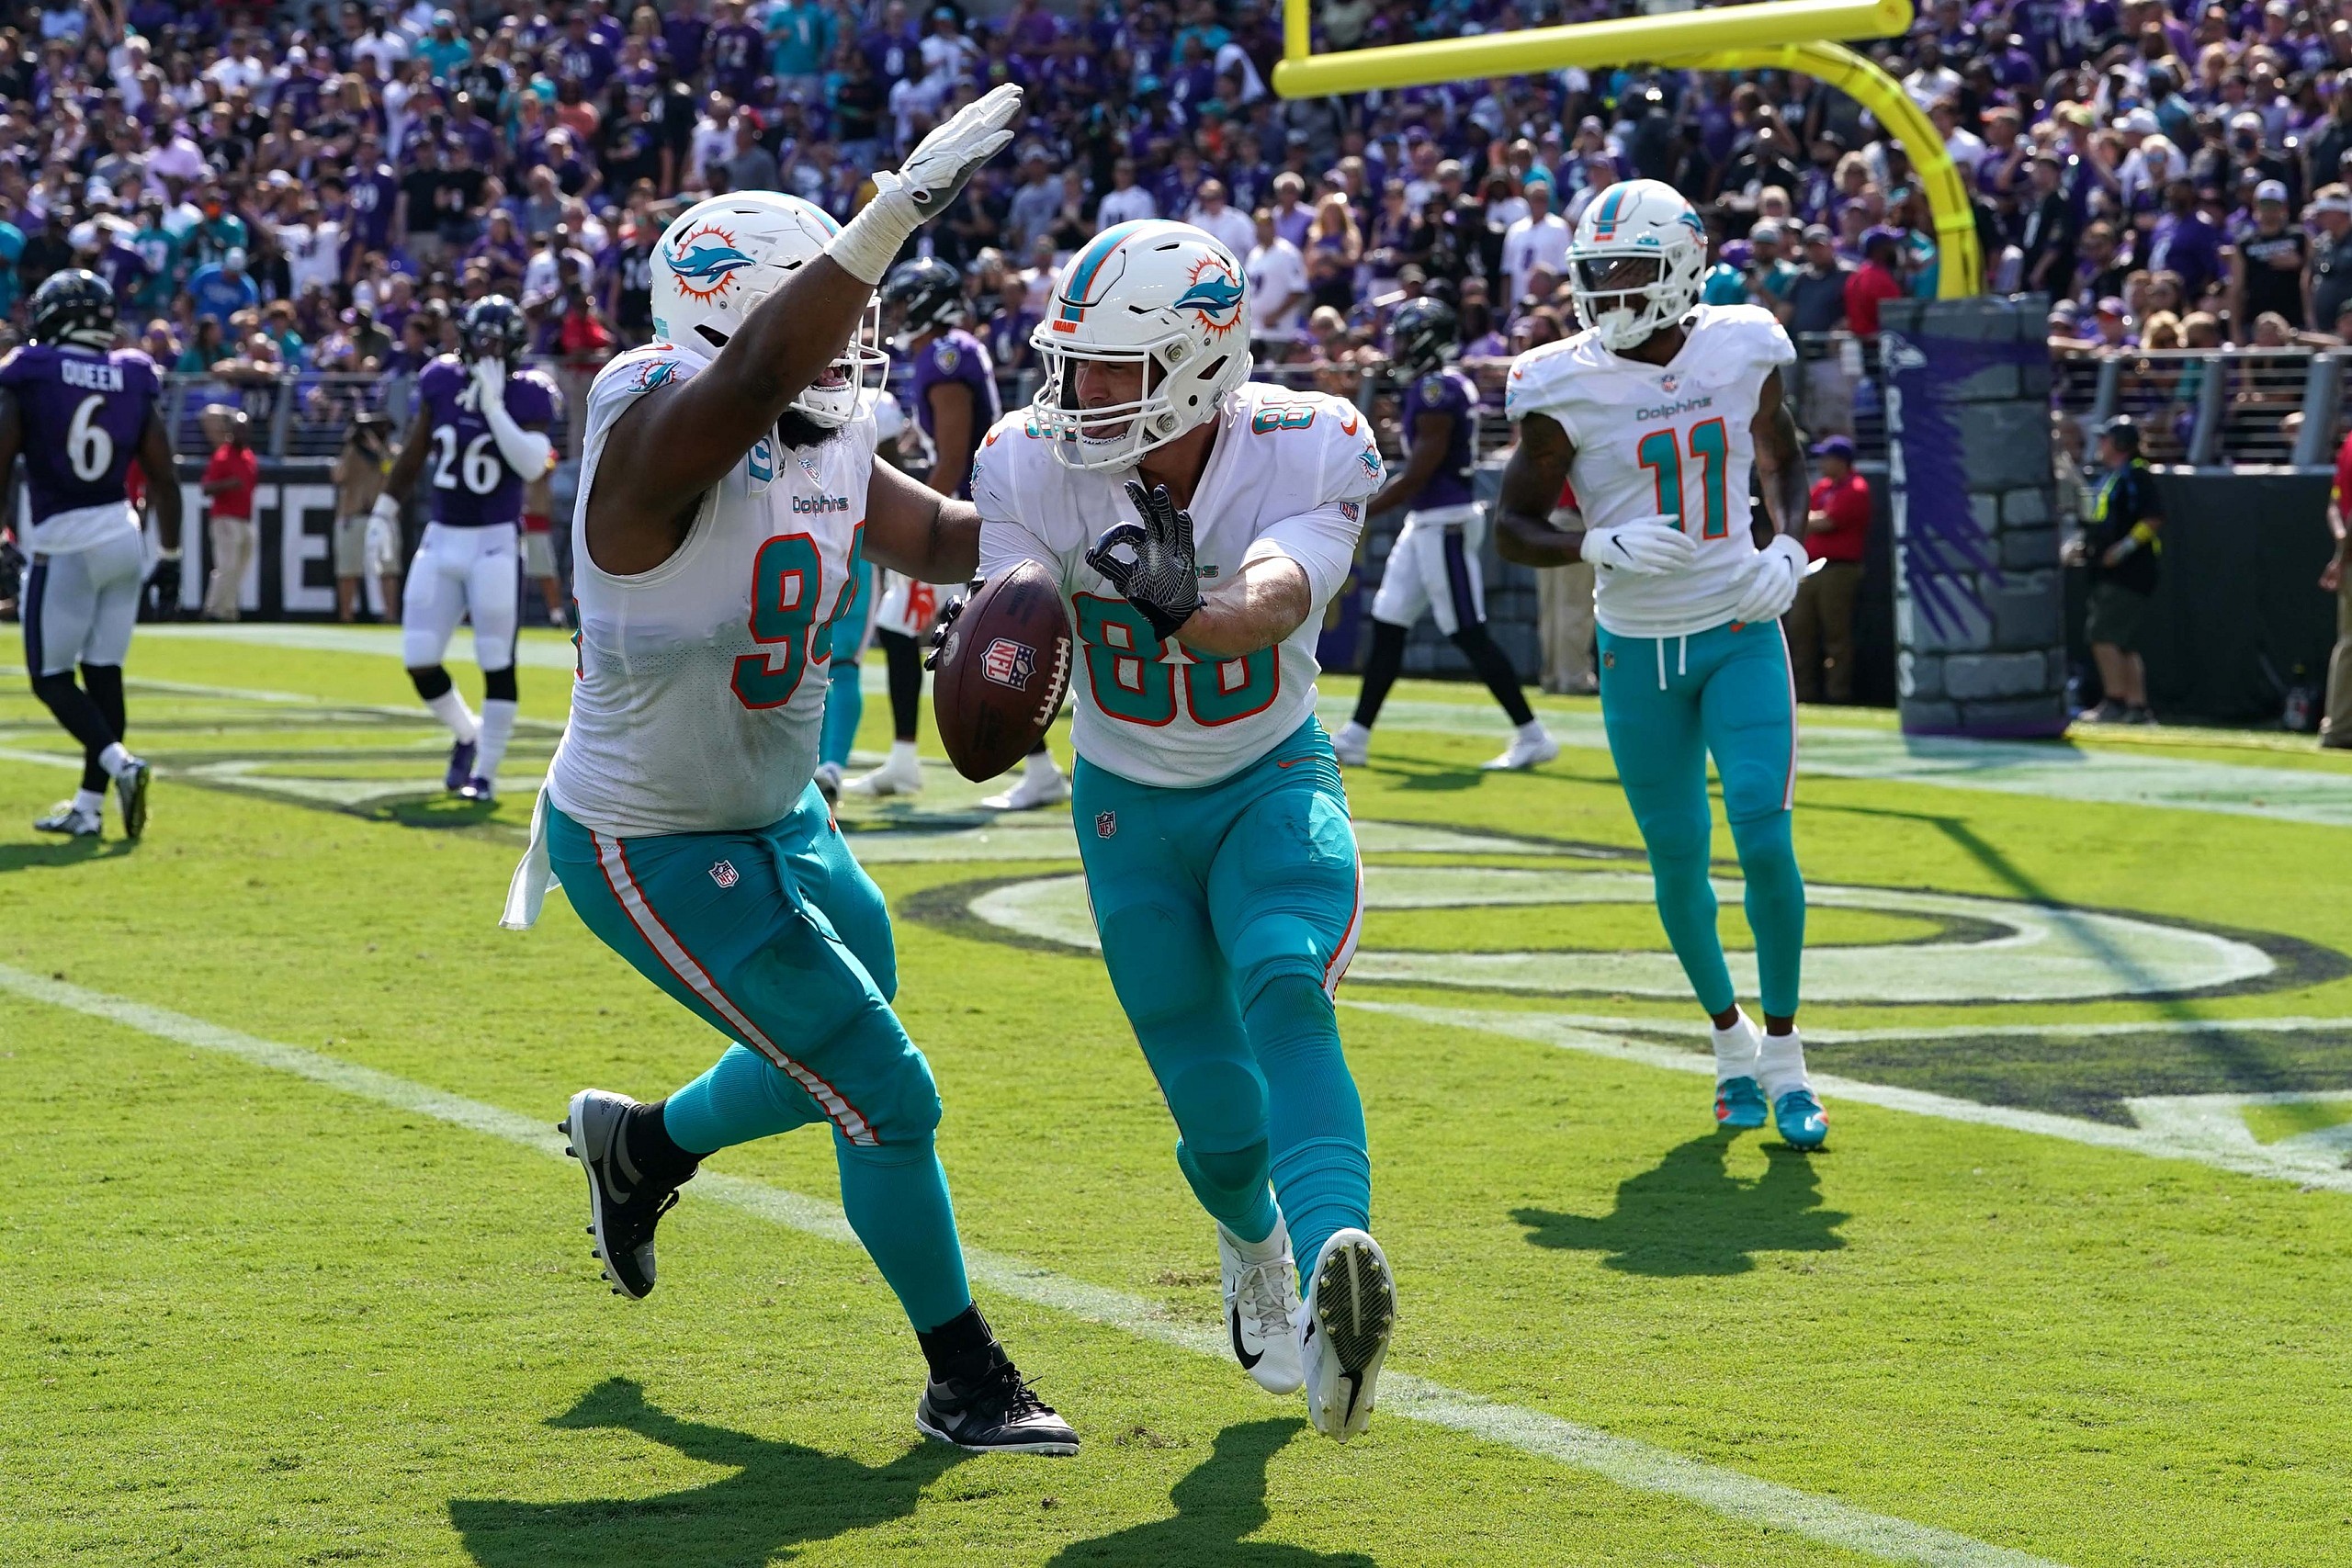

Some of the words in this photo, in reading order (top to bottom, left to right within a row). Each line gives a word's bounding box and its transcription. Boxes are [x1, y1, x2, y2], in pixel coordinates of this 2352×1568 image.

[61, 359, 125, 393] QUEEN
[1636, 397, 1713, 422] Dolphins
[67, 394, 114, 483] 6
[432, 423, 503, 495] 26
[1638, 416, 1729, 539] 11
[792, 494, 850, 518] Dolphins
[989, 641, 1018, 681] NFL
[1071, 591, 1281, 728] 88
[1098, 823, 1114, 837] NFL
[717, 867, 736, 887] NFL
